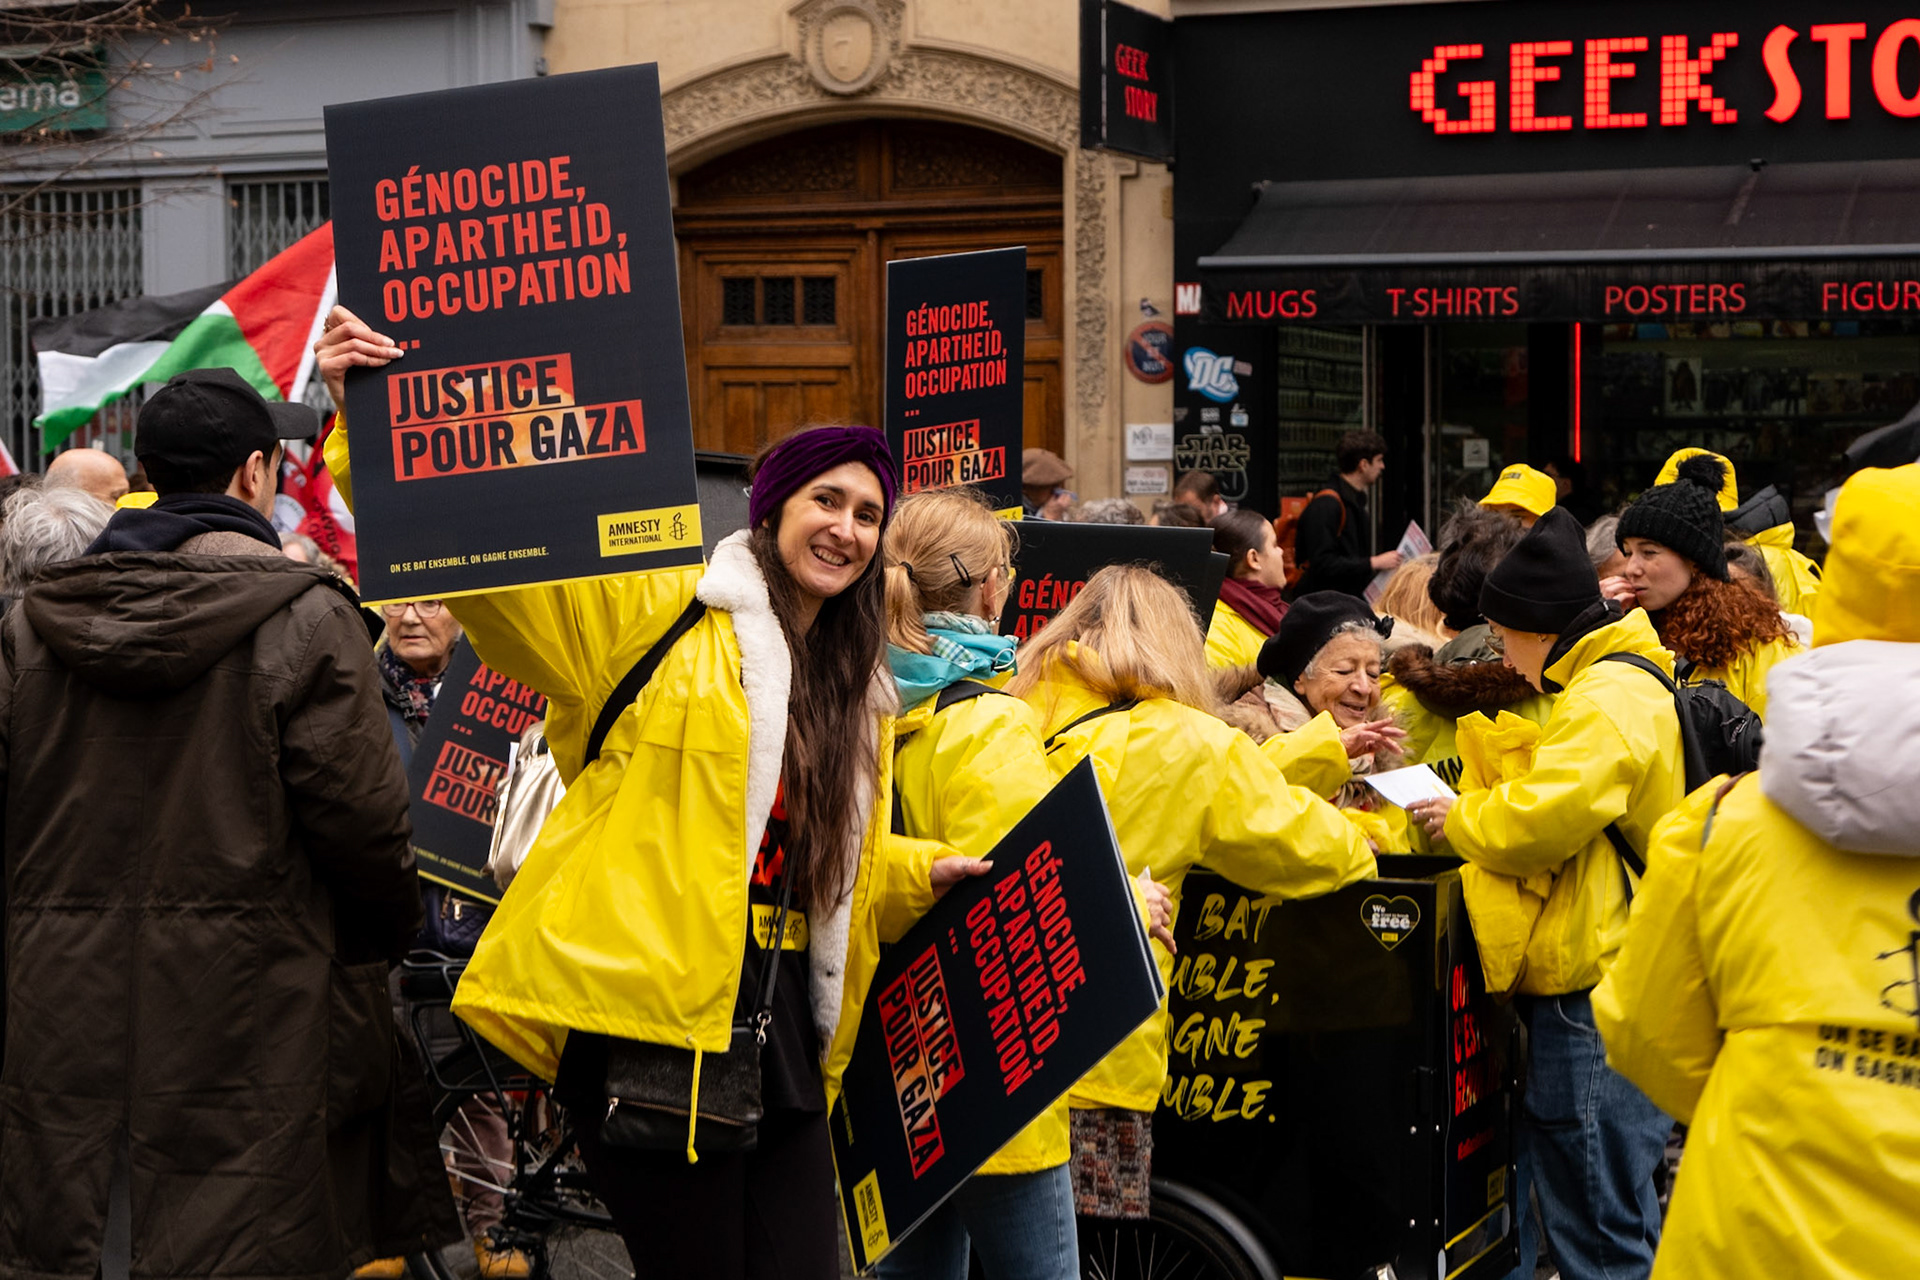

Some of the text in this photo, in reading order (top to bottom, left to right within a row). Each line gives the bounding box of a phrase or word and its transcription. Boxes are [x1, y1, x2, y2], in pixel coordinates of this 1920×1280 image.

[1114, 43, 1149, 82] GEEK
[1409, 18, 1920, 134] GEEK STO
[1125, 85, 1157, 122] STORY
[375, 155, 586, 222] GÉNOCIDE,
[379, 202, 627, 272] APARTHEID,
[383, 251, 631, 322] OCCUPATION
[1226, 289, 1317, 319] MUGS
[1386, 286, 1519, 317] T-SHIRTS
[1604, 282, 1746, 315] POSTERS
[906, 300, 993, 337] GÉNOCIDE,
[905, 329, 1007, 368] APARTHEID,
[396, 360, 562, 423] JUSTICE
[905, 358, 1007, 399] OCCUPATION
[401, 406, 638, 476] POUR GAZA
[906, 422, 974, 460] JUSTICE
[1176, 451, 1248, 472] WARS
[1177, 434, 1249, 453] STAR
[907, 448, 1002, 493] POUR GAZA
[608, 518, 661, 537] AMNESTY
[609, 534, 662, 547] INTERNATIONAL
[390, 563, 401, 573] ON
[402, 562, 412, 572] SE
[413, 560, 427, 571] BAT
[470, 554, 481, 564] ON
[482, 551, 507, 562] GAGNE
[429, 775, 496, 822] POUR
[1025, 840, 1086, 1014] GÉNOCIDE,
[1193, 893, 1282, 943] BAT
[1371, 912, 1410, 929] free
[994, 869, 1060, 1071] APARTHEID,
[966, 897, 1033, 1097] OCCUPATION
[910, 954, 960, 1090] JUSTICE
[881, 980, 940, 1168] POUR GAZA
[1855, 1055, 1920, 1090] GAGN
